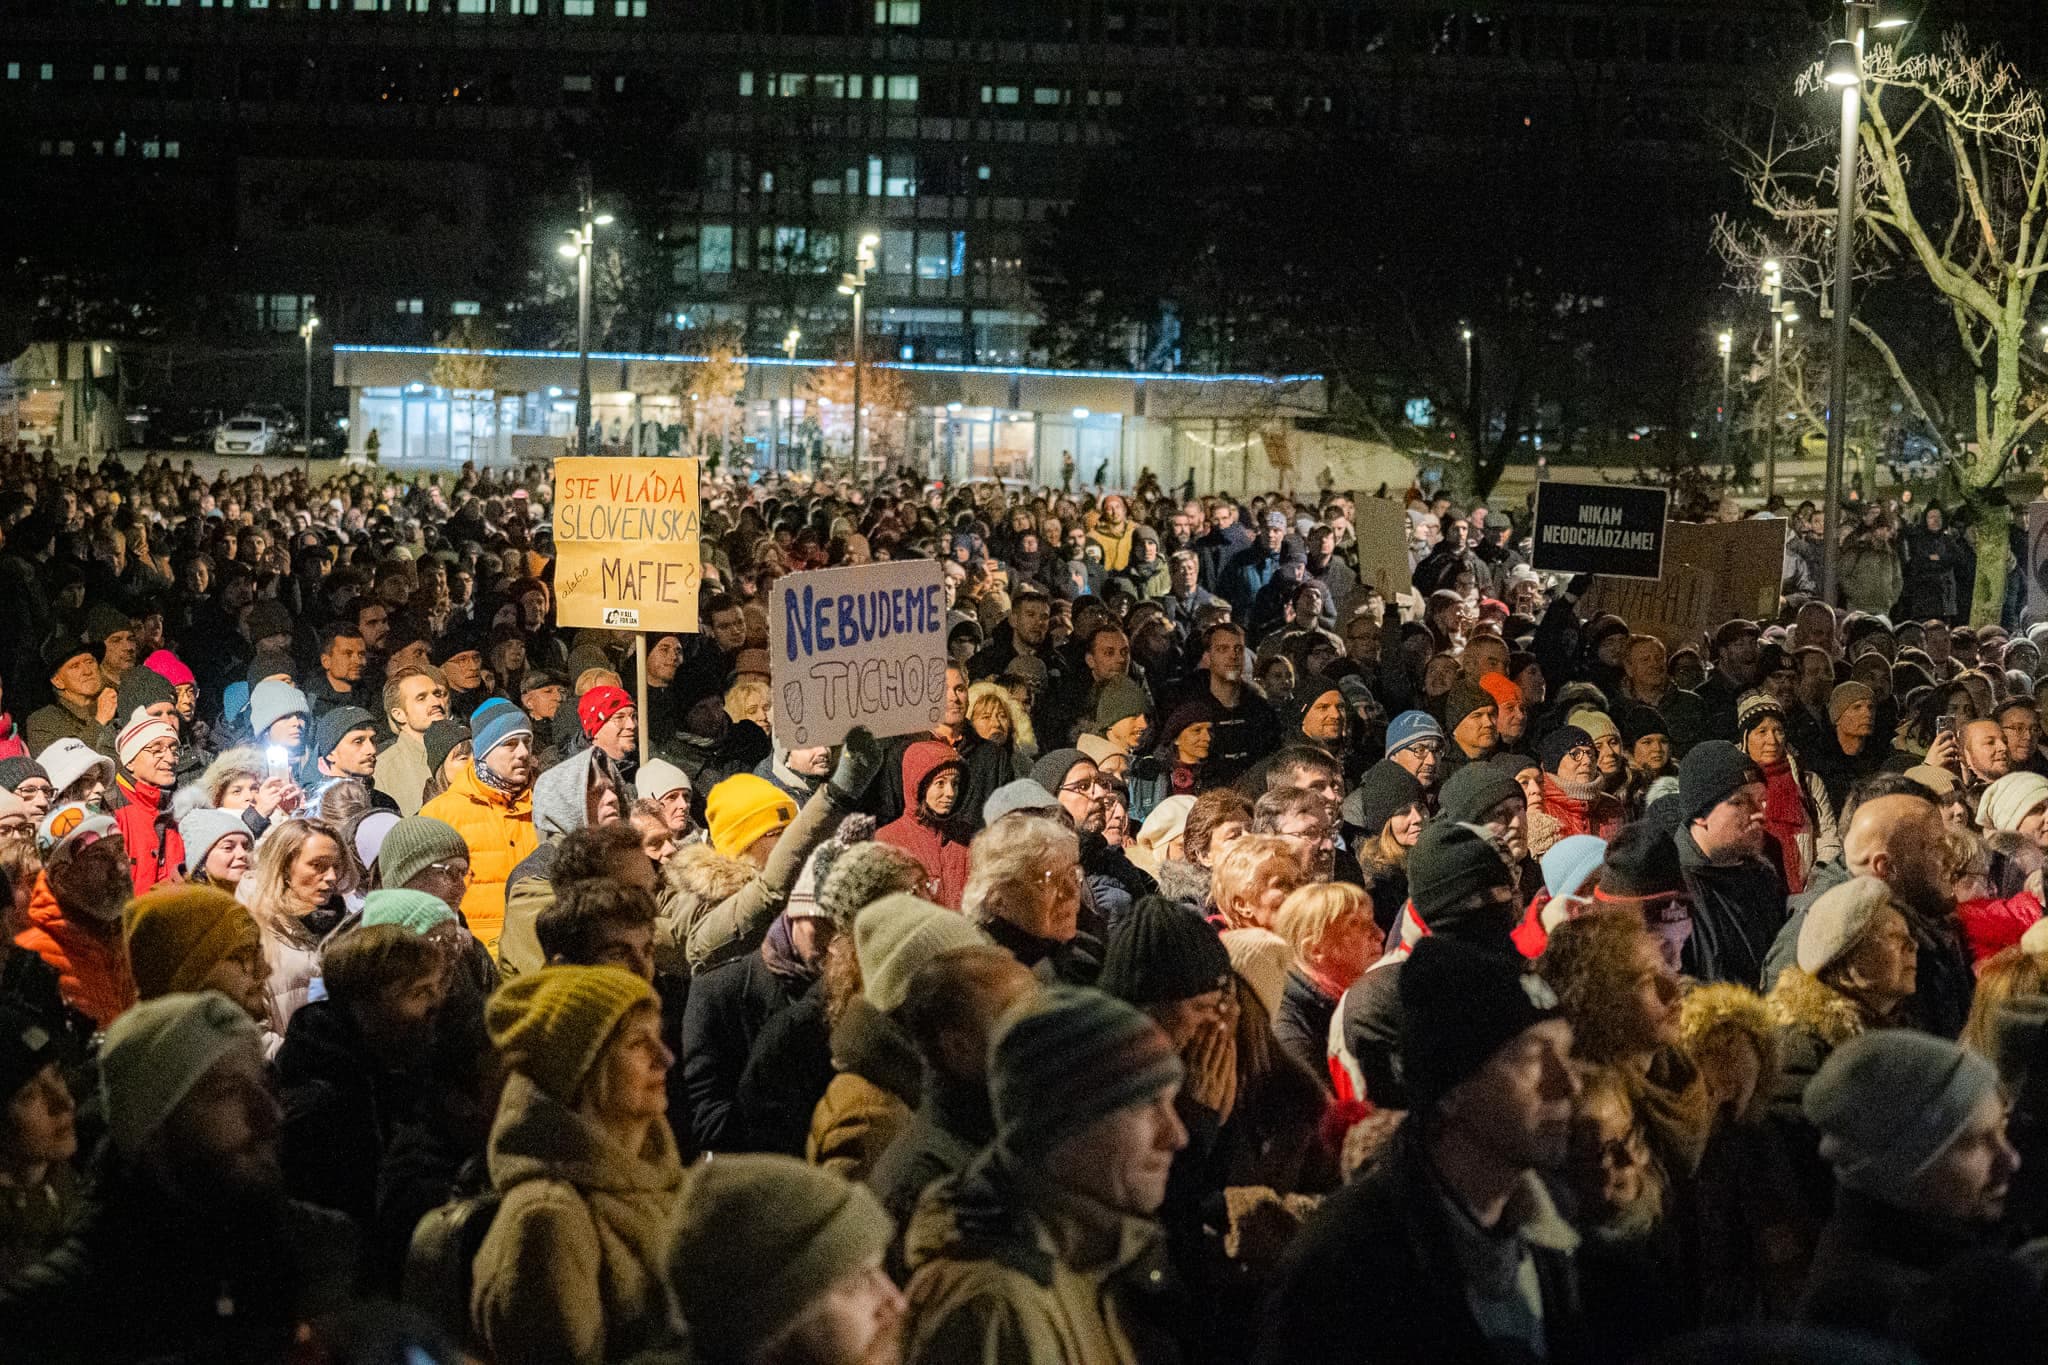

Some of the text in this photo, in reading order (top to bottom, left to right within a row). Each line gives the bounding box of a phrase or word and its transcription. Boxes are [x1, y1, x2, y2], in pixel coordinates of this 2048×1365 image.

[564, 470, 686, 503] STE VLÁDA
[560, 504, 699, 541] SLOVENSKA
[1578, 504, 1623, 526] NIKAM
[1542, 524, 1655, 551] NEODCHÁDZAME!
[784, 584, 941, 662] NEBUDEME
